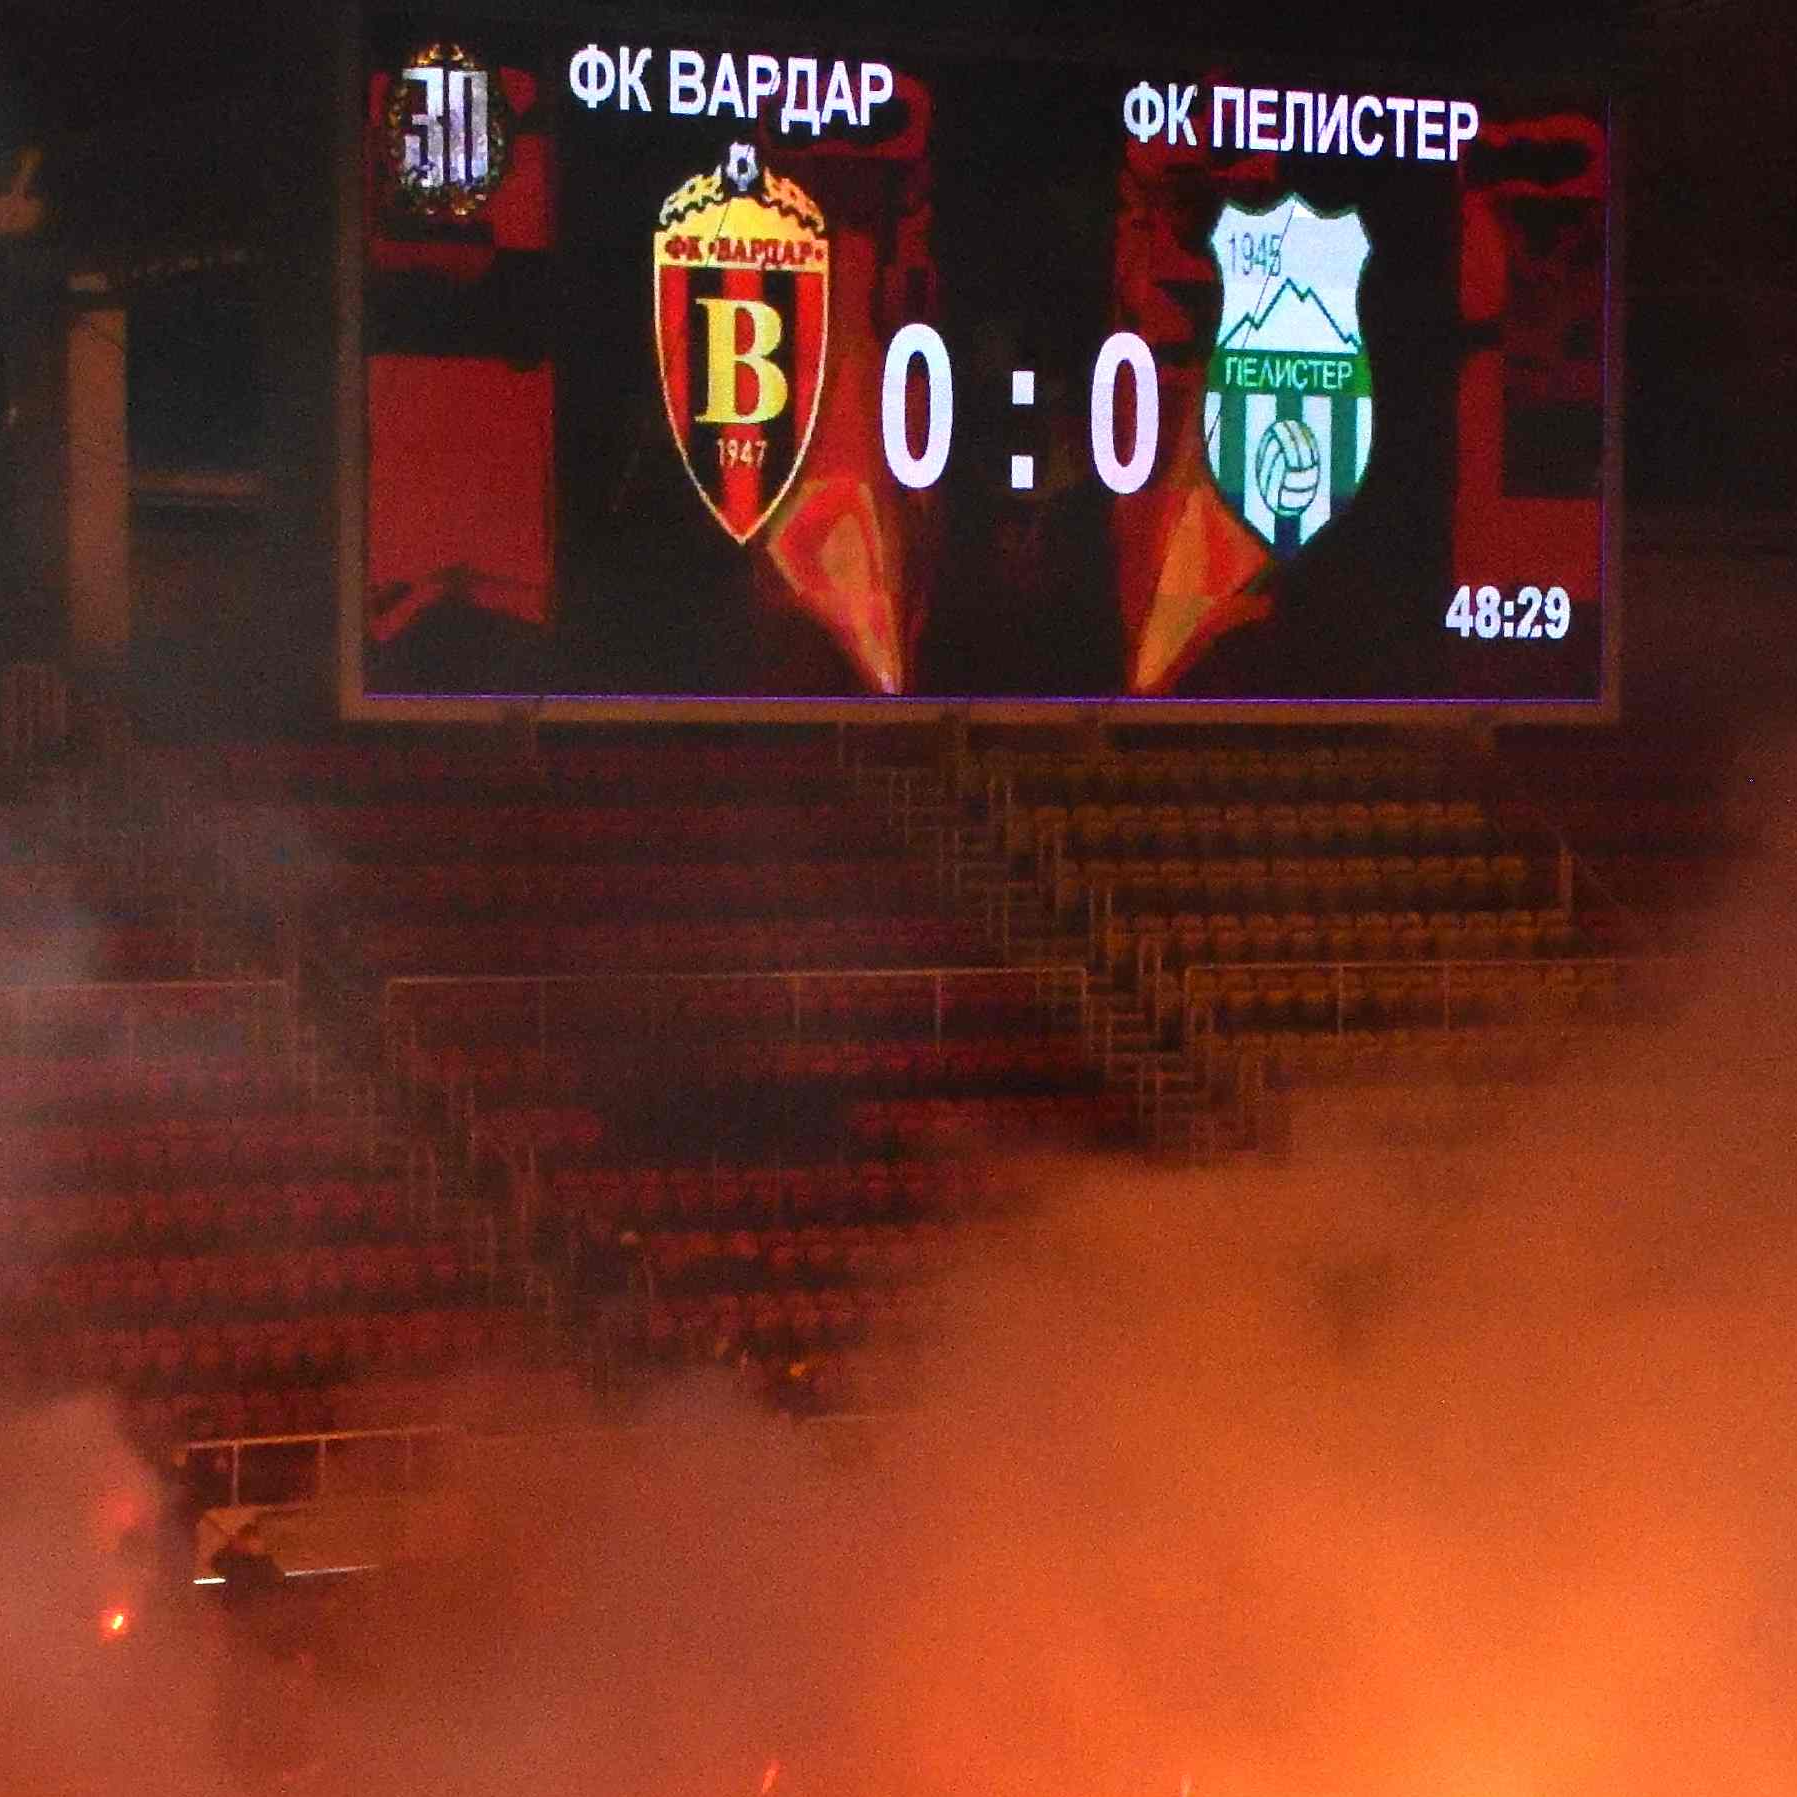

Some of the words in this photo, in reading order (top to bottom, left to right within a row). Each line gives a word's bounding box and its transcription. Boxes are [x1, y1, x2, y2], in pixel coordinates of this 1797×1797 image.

[568, 43, 652, 113] ФК
[668, 49, 894, 136] ВАРДАР
[1122, 81, 1198, 146] ФК
[1212, 86, 1480, 162] ПЕЛИСТЕР
[881, 323, 954, 489] 0
[1090, 332, 1160, 495] 0
[1224, 356, 1354, 392] ПЕЛИСТЕР
[1445, 584, 1571, 640] 48:29
